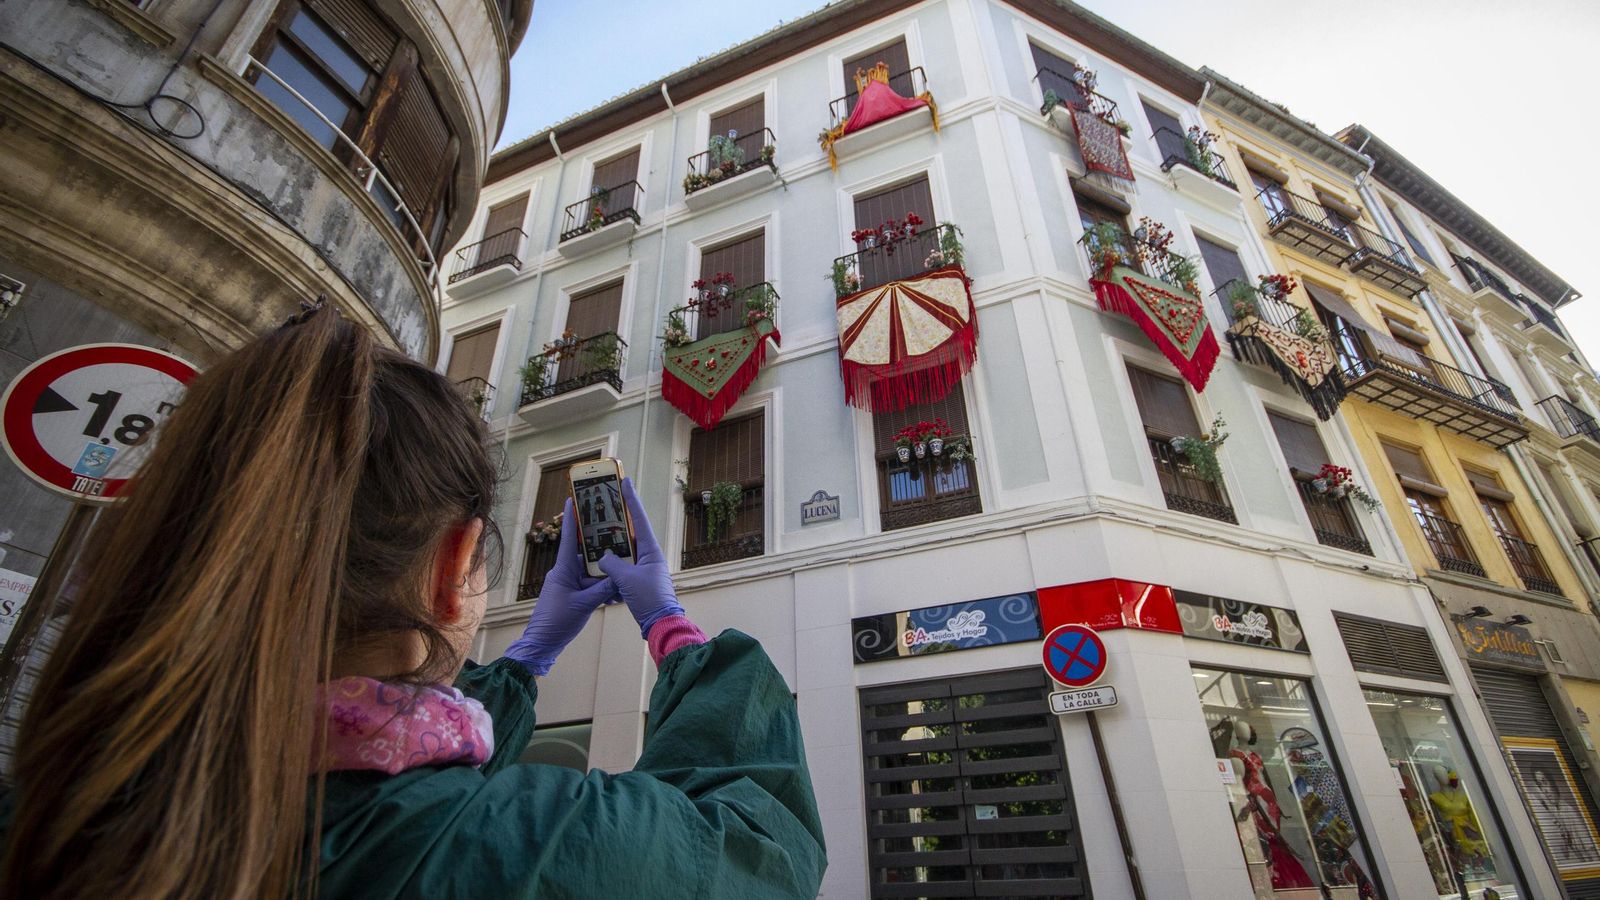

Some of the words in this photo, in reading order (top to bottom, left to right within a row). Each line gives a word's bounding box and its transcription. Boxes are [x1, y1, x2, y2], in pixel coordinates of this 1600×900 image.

[804, 503, 838, 519] LUCENA
[931, 631, 955, 642] Tejidos
[962, 627, 985, 638] Hogar
[1062, 694, 1074, 702] EN
[1076, 691, 1100, 699] TODA
[1076, 698, 1103, 707] CALLE
